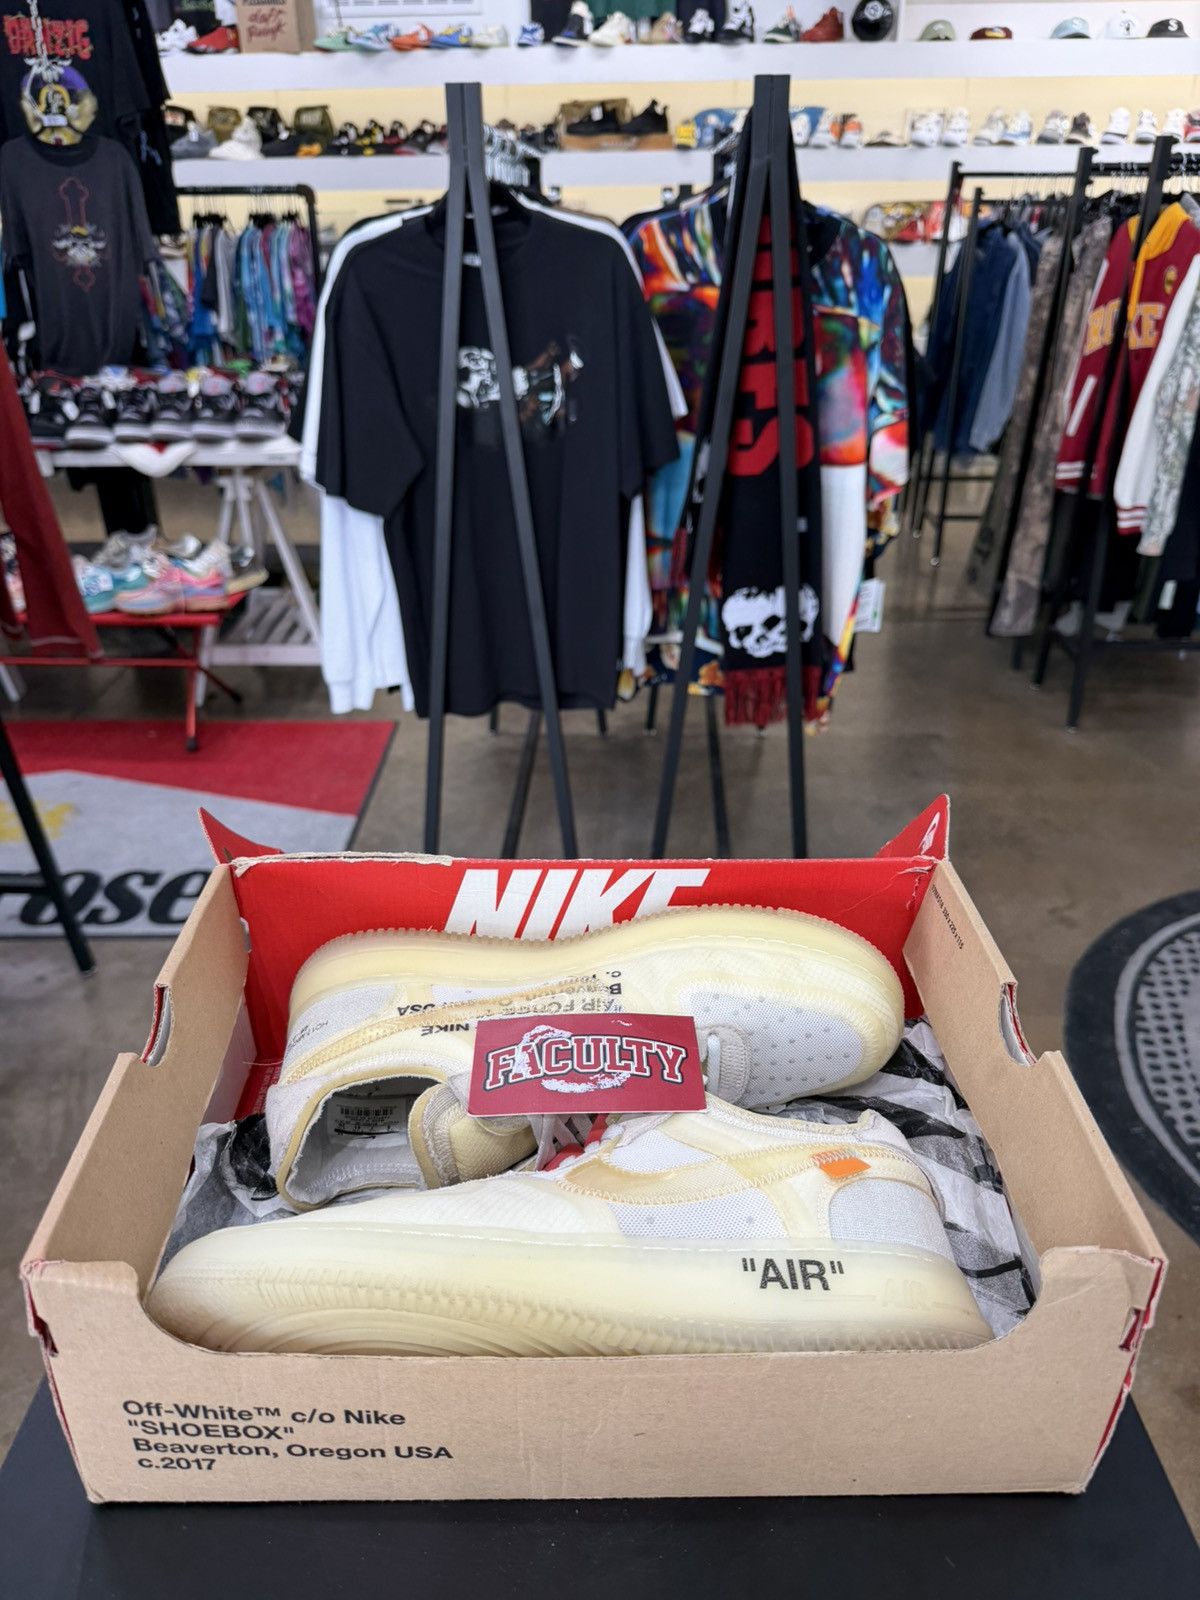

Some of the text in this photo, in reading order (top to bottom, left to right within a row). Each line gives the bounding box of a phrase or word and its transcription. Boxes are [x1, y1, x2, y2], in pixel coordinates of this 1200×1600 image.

[1168, 19, 1179, 32] S
[420, 1023, 470, 1037] NIKE
[484, 1035, 687, 1091] FACULTY
[741, 1256, 845, 1291] "AIR"
[290, 1408, 336, 1425] c/o
[344, 1409, 406, 1425] Nike
[127, 1419, 295, 1440] "SHOEBOX"
[132, 1436, 454, 1461] Beaverton, Oregon USA
[137, 1456, 217, 1472] c.2017
